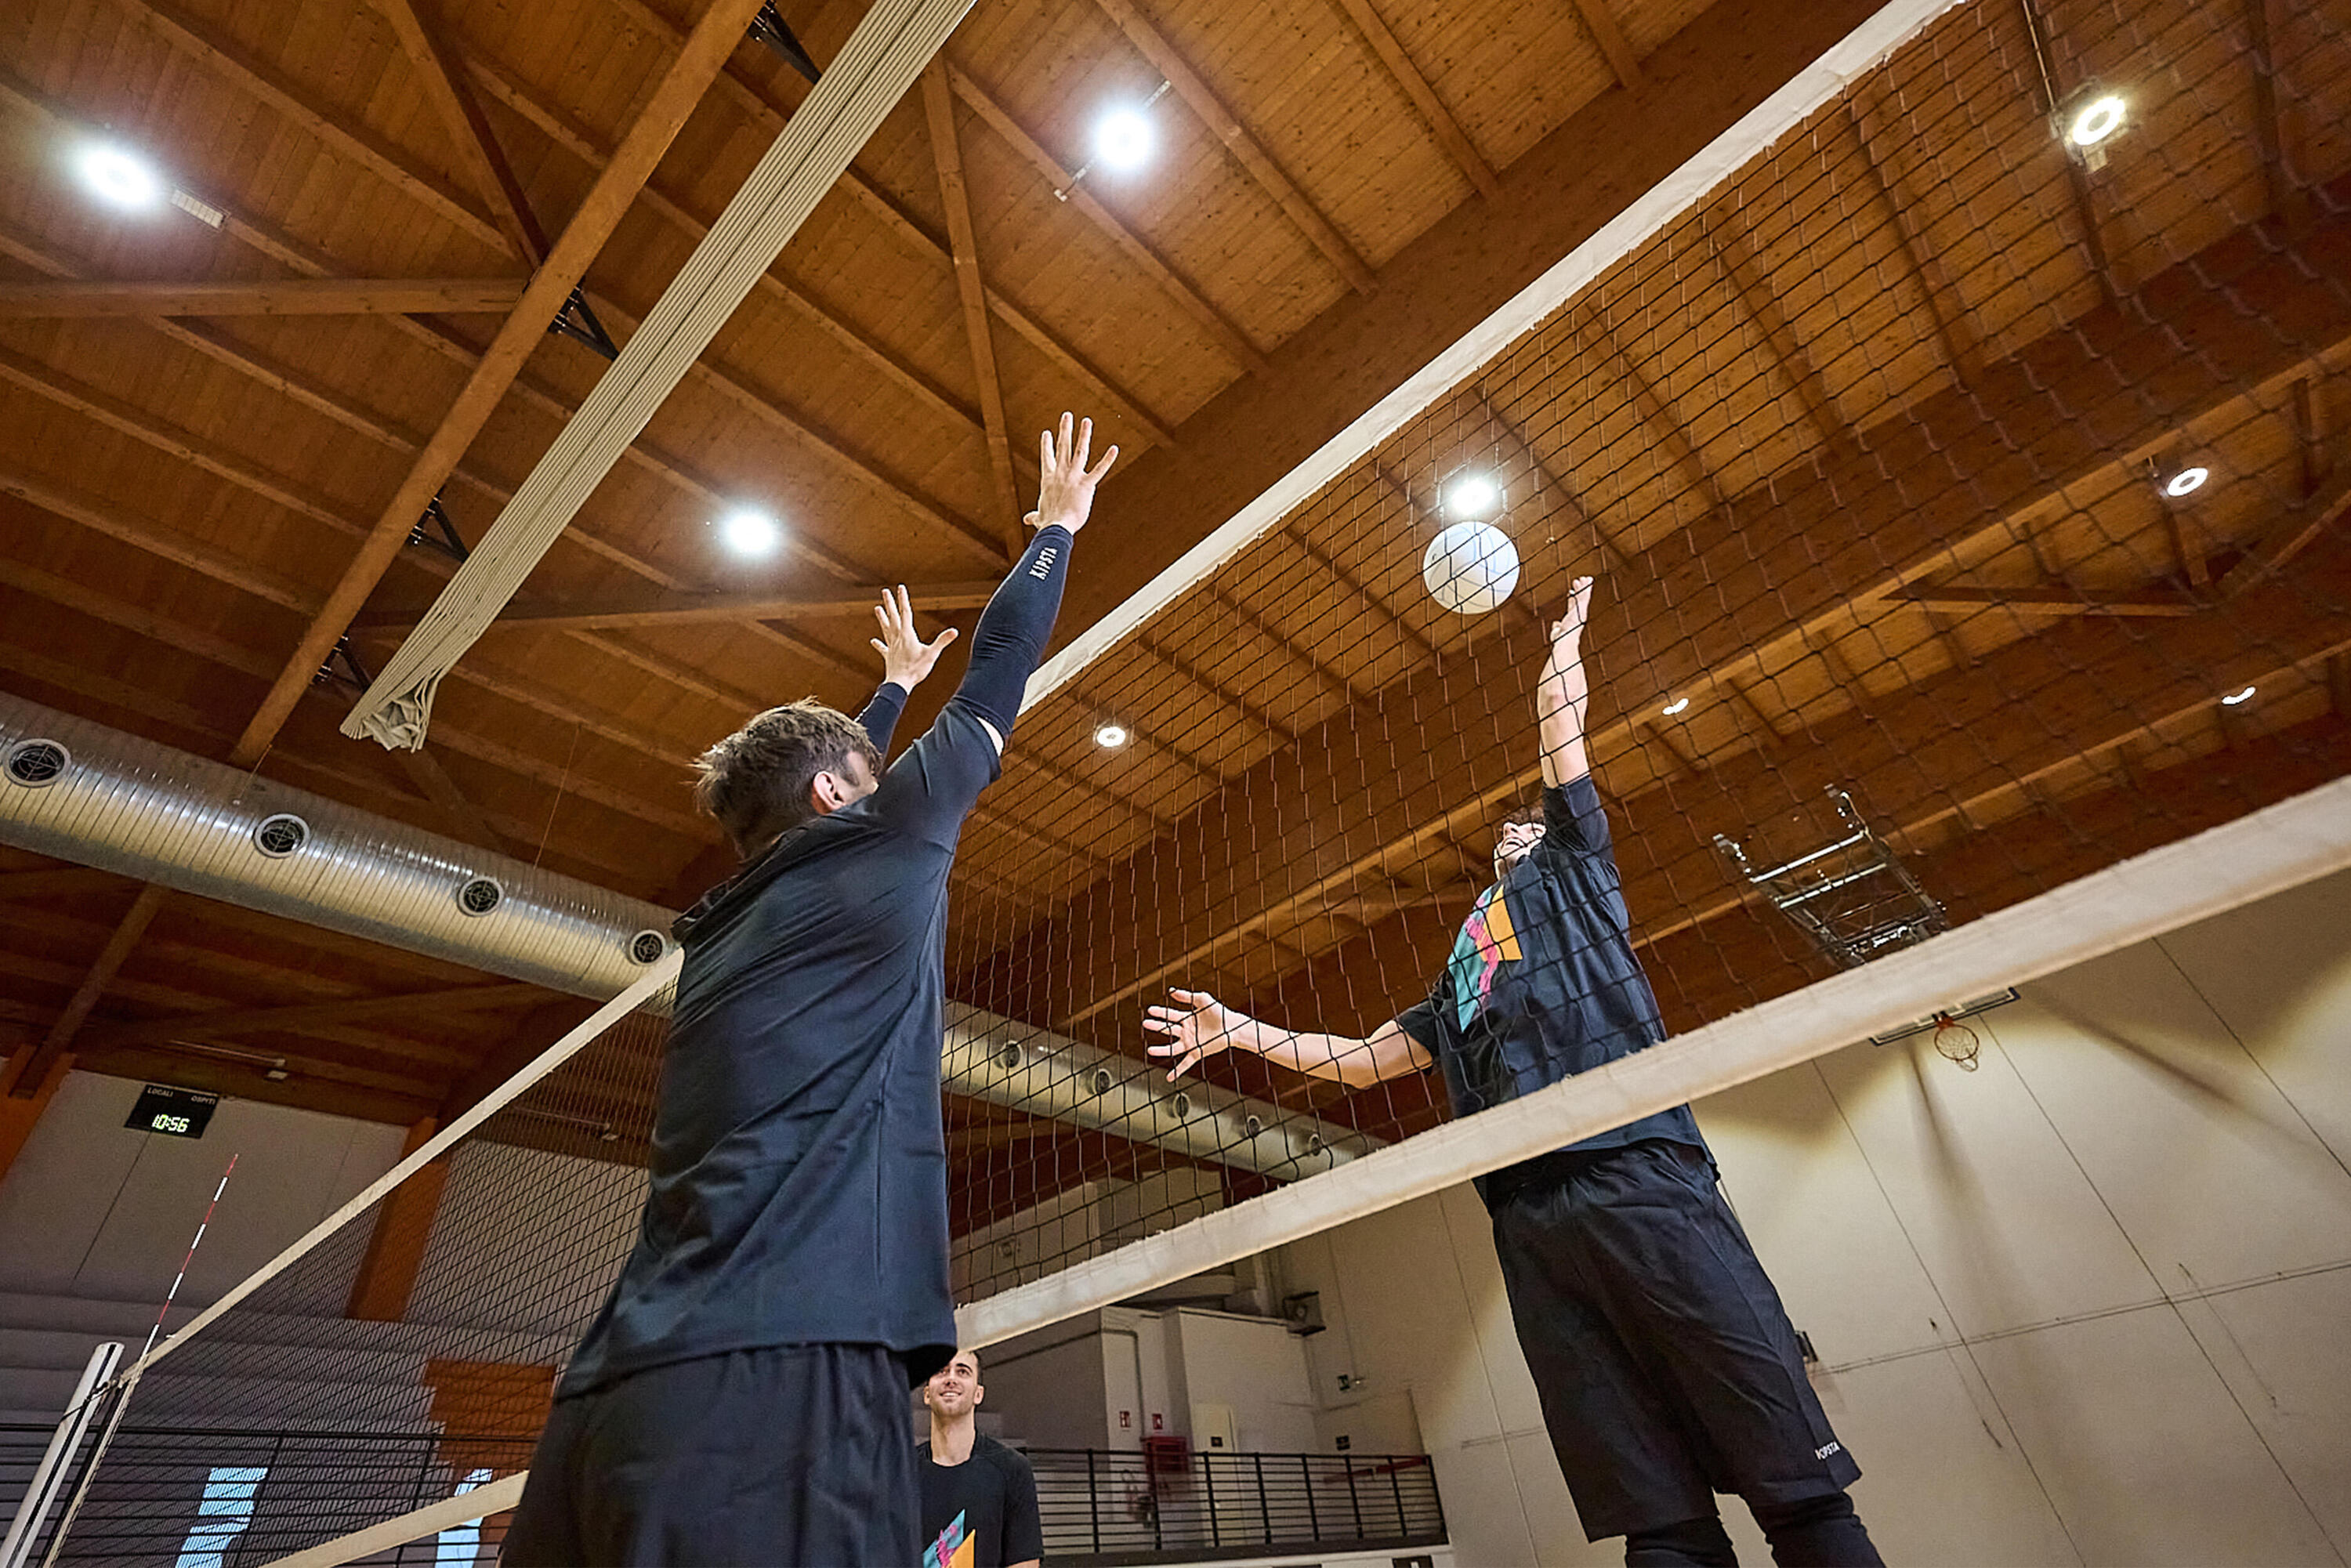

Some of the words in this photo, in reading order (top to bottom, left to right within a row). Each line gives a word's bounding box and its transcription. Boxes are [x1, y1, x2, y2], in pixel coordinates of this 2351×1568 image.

[1029, 547, 1058, 581] KIPSTA
[147, 1087, 174, 1097] LOCALI
[151, 1114, 190, 1133] 10:56
